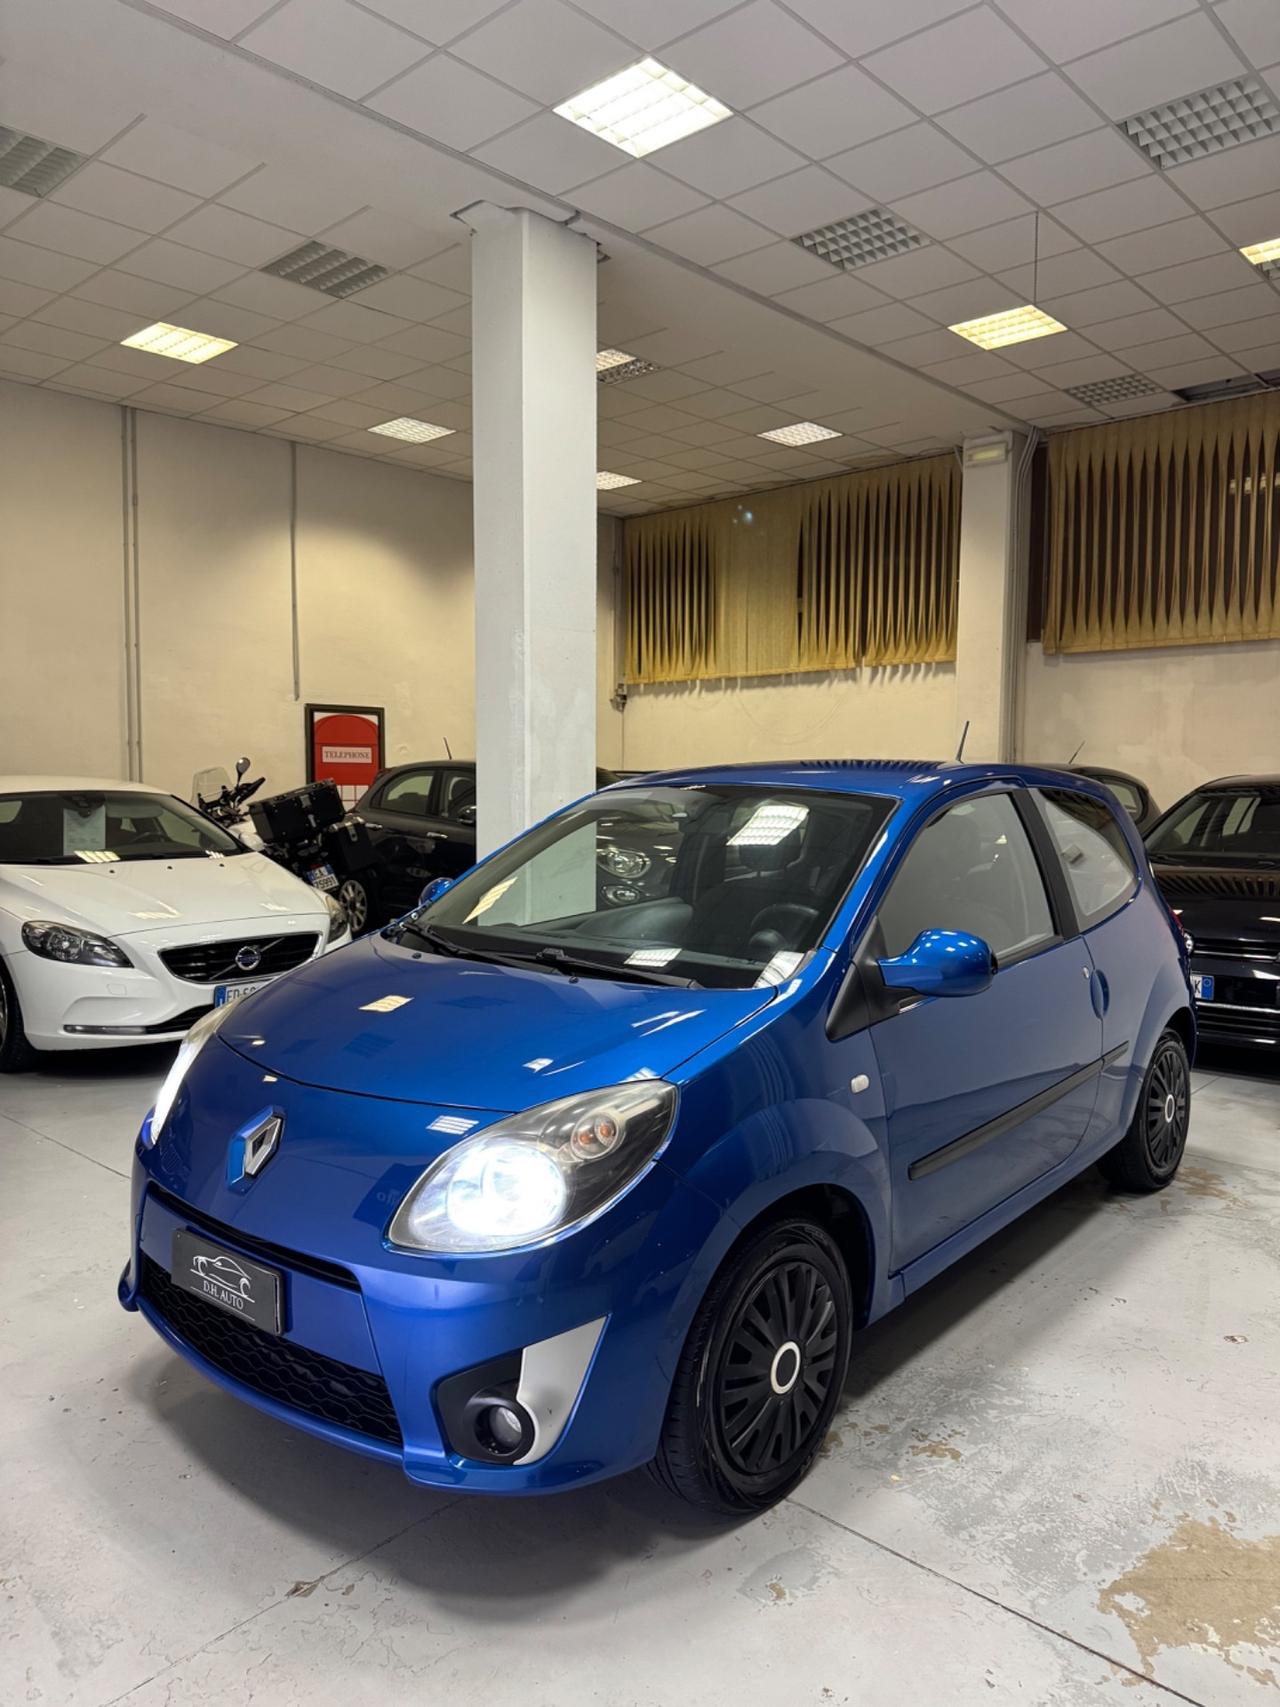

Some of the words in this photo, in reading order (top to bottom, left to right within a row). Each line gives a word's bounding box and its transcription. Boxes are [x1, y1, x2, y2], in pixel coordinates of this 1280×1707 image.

[324, 750, 370, 760] TELEPHONE
[203, 1280, 219, 1297] D.H.
[219, 1290, 244, 1310] AUTO
